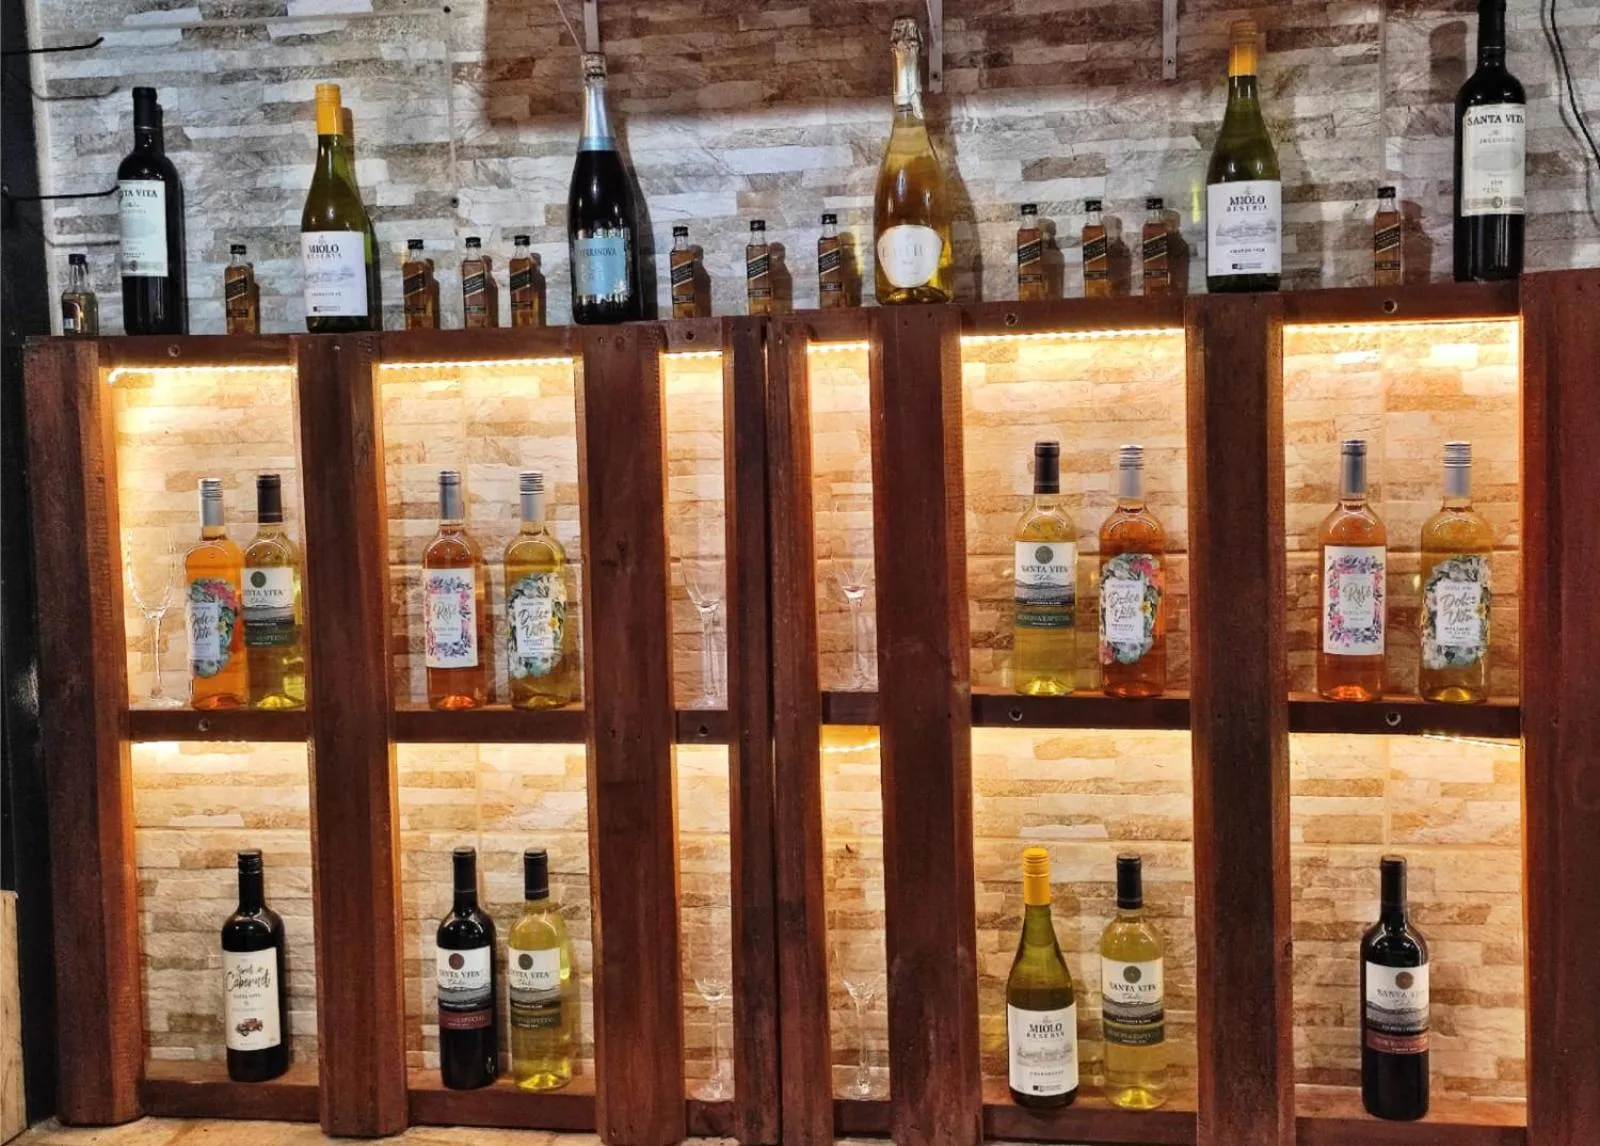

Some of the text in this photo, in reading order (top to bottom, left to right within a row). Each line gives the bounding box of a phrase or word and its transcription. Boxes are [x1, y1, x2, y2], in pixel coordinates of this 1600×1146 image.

[1467, 114, 1502, 126] SANTA
[136, 189, 158, 198] VITA
[263, 589, 284, 597] VITA
[1028, 1022, 1064, 1034] MIOLO
